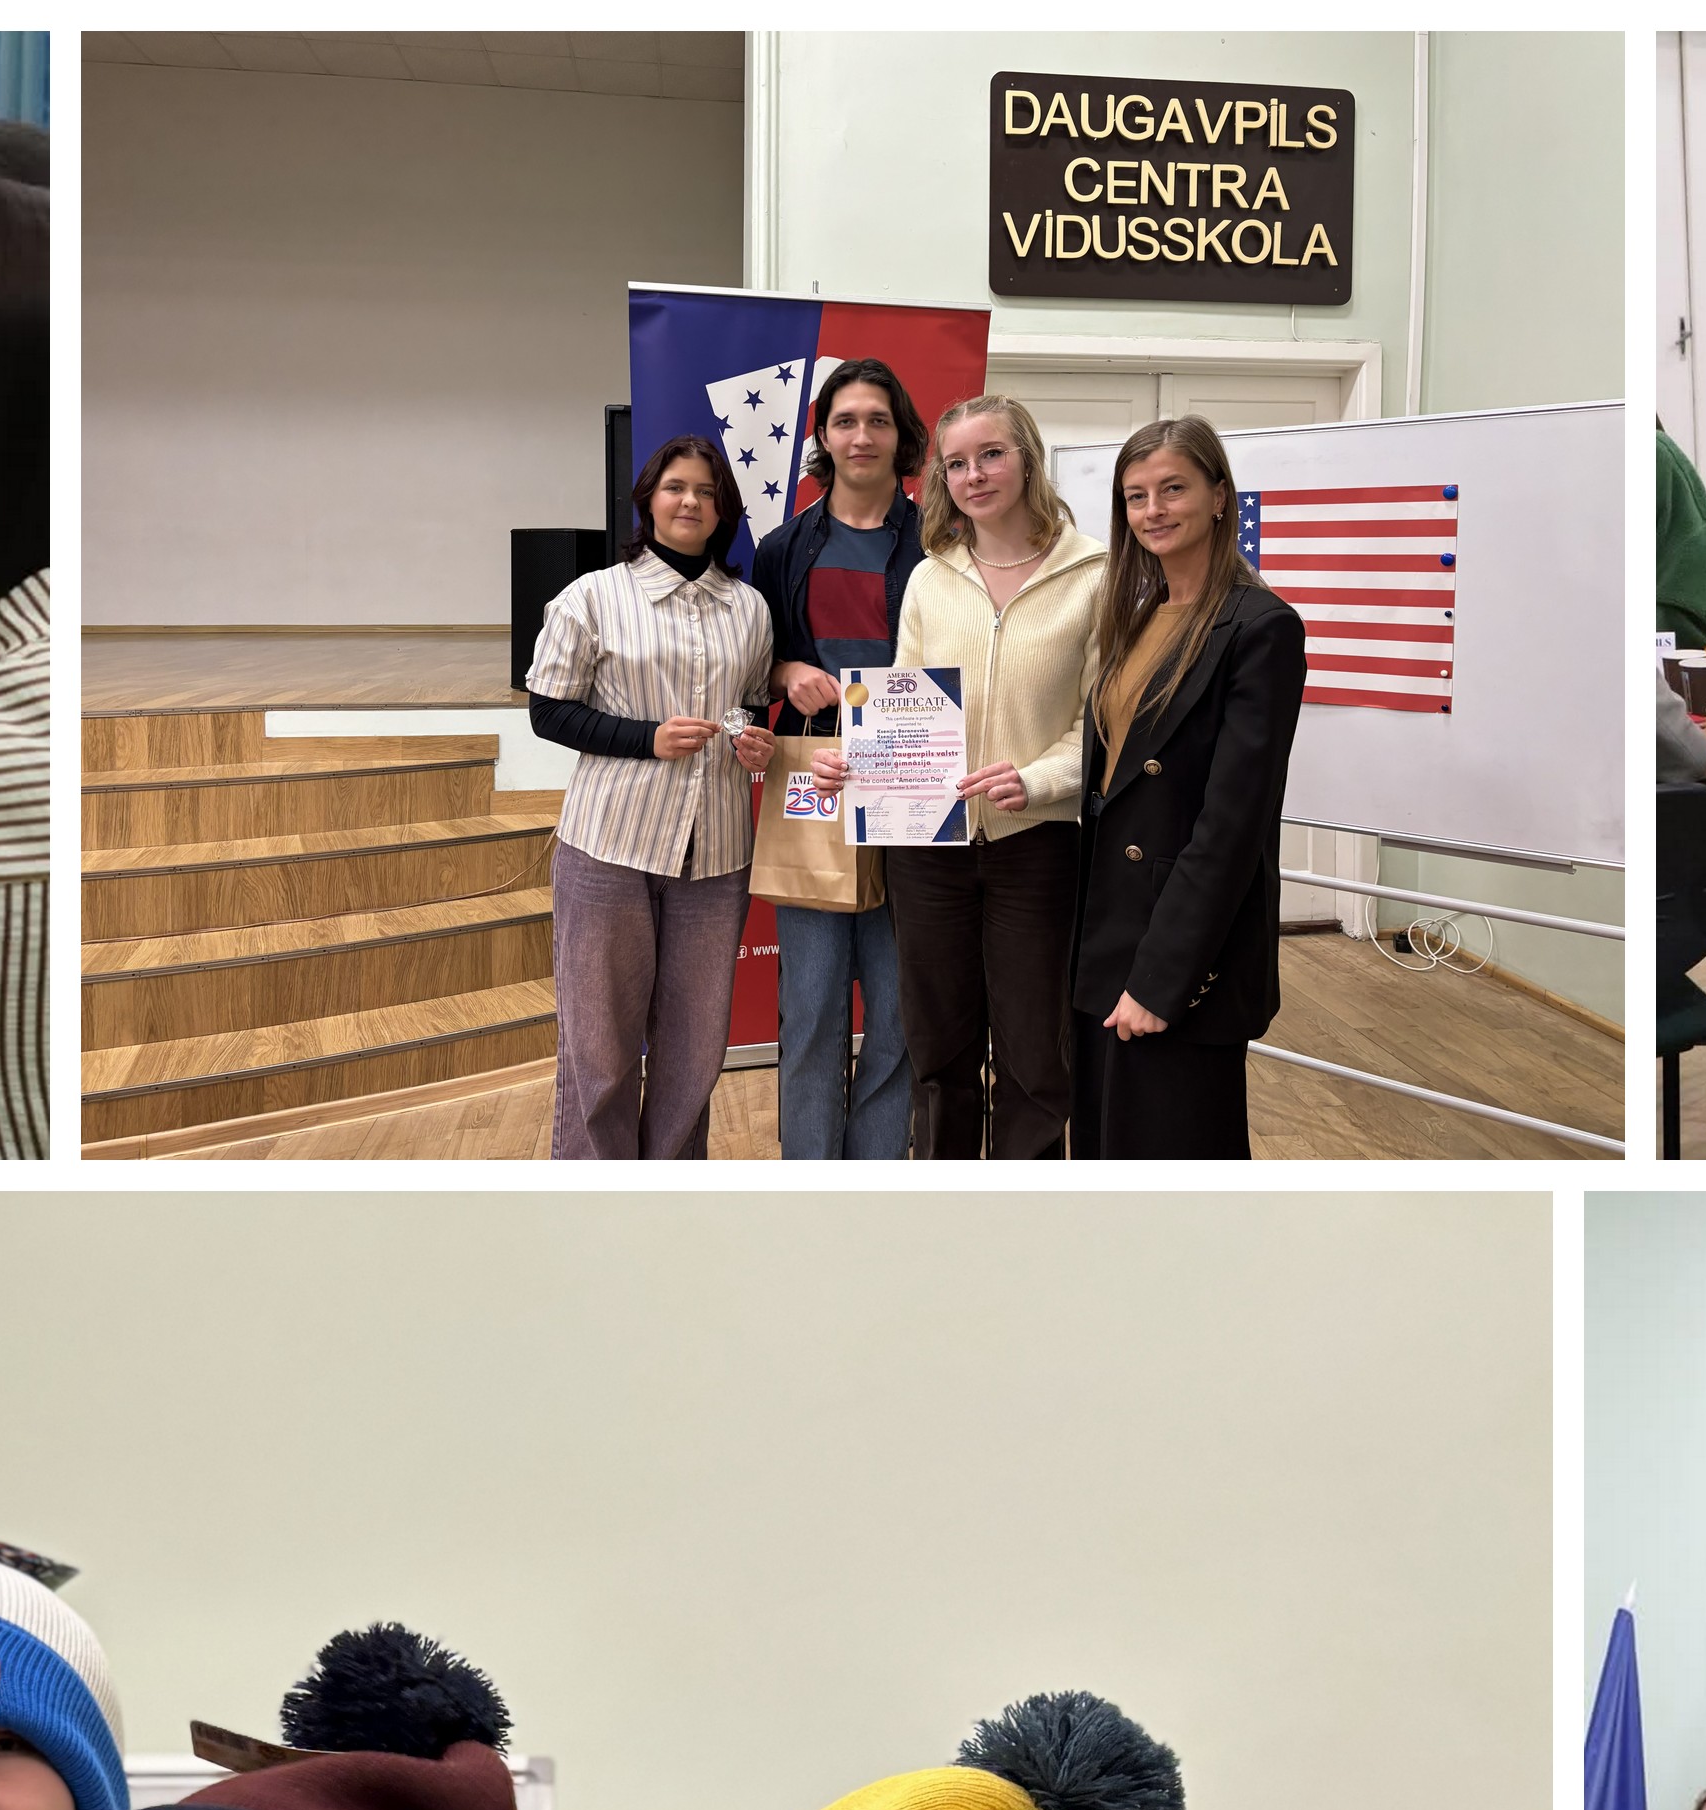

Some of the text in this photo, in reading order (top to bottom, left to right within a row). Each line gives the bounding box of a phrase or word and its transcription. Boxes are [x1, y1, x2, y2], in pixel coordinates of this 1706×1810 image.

[1064, 156, 1290, 211] CENTRA
[887, 679, 918, 693] 250
[873, 697, 948, 708] CERTIFICATE
[892, 751, 934, 759] Daugavpils
[875, 760, 891, 768] poļu
[900, 768, 941, 777] participation
[786, 787, 838, 817] 250
